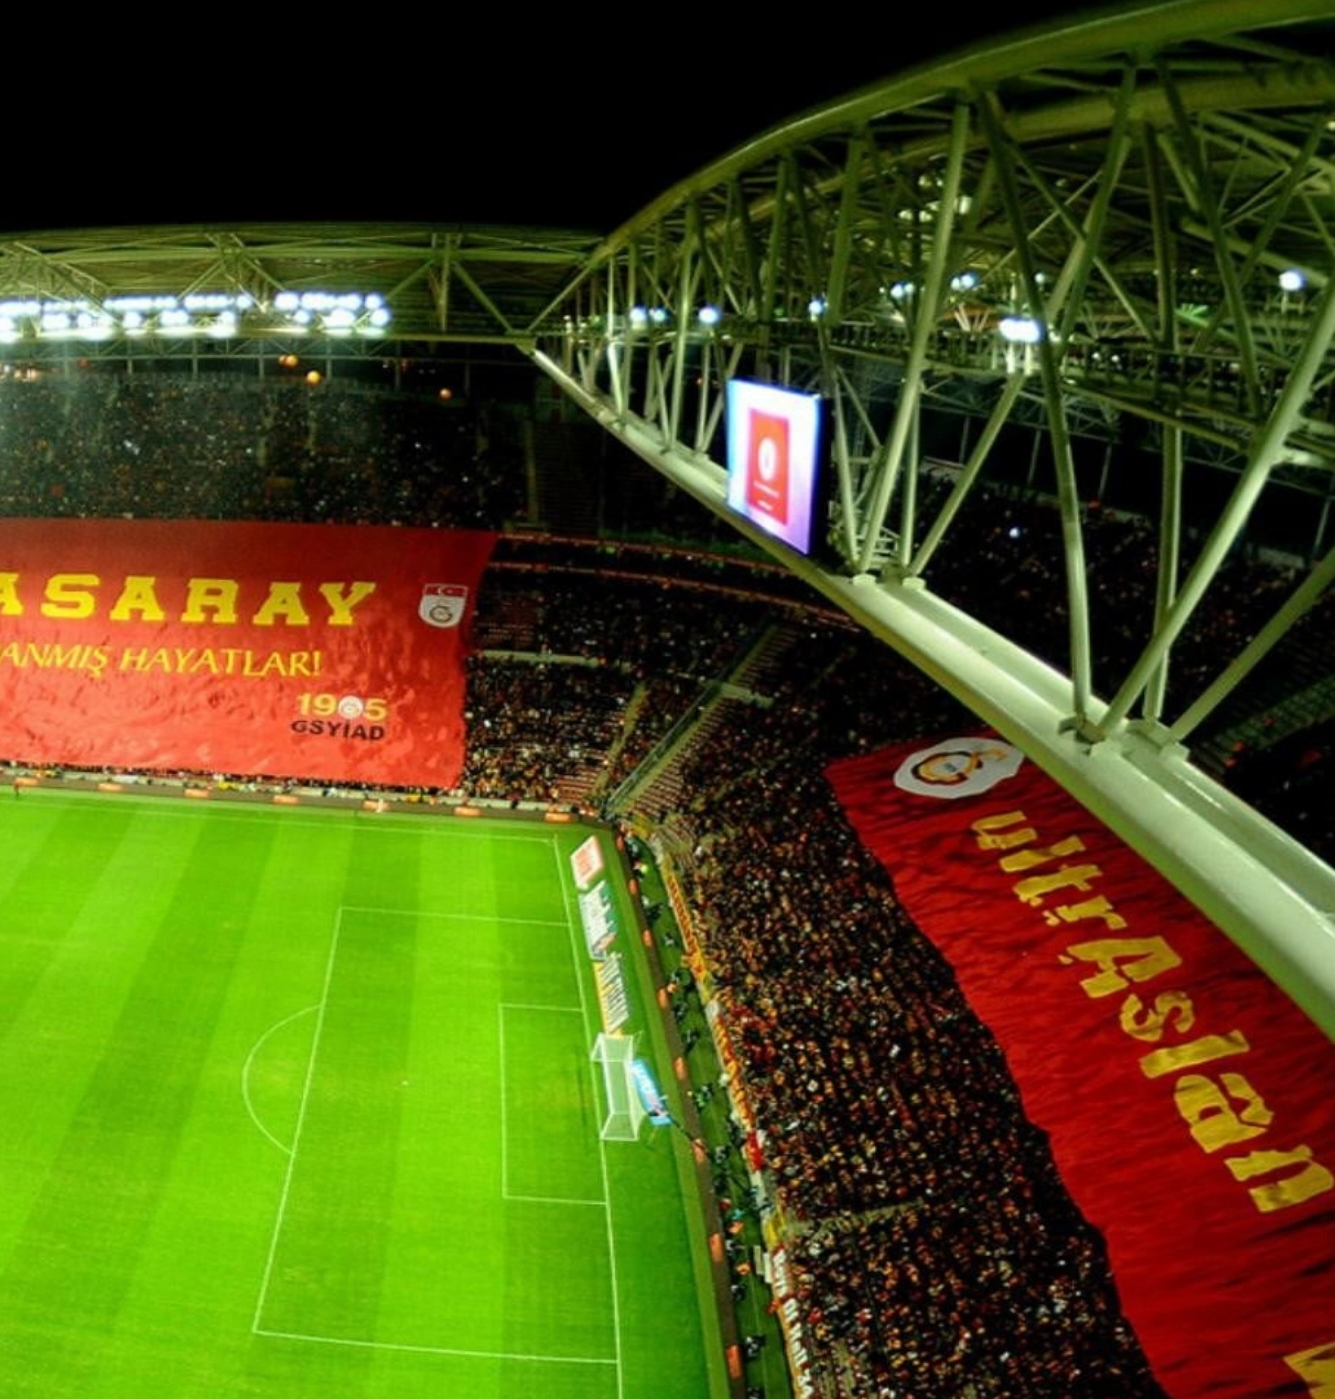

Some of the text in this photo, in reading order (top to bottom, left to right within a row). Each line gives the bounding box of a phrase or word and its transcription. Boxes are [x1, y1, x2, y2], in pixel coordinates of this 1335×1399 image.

[119, 647, 321, 678] HAYATLAR!
[291, 719, 386, 741] GSYİAD
[969, 810, 1335, 1213] ultrAslan
